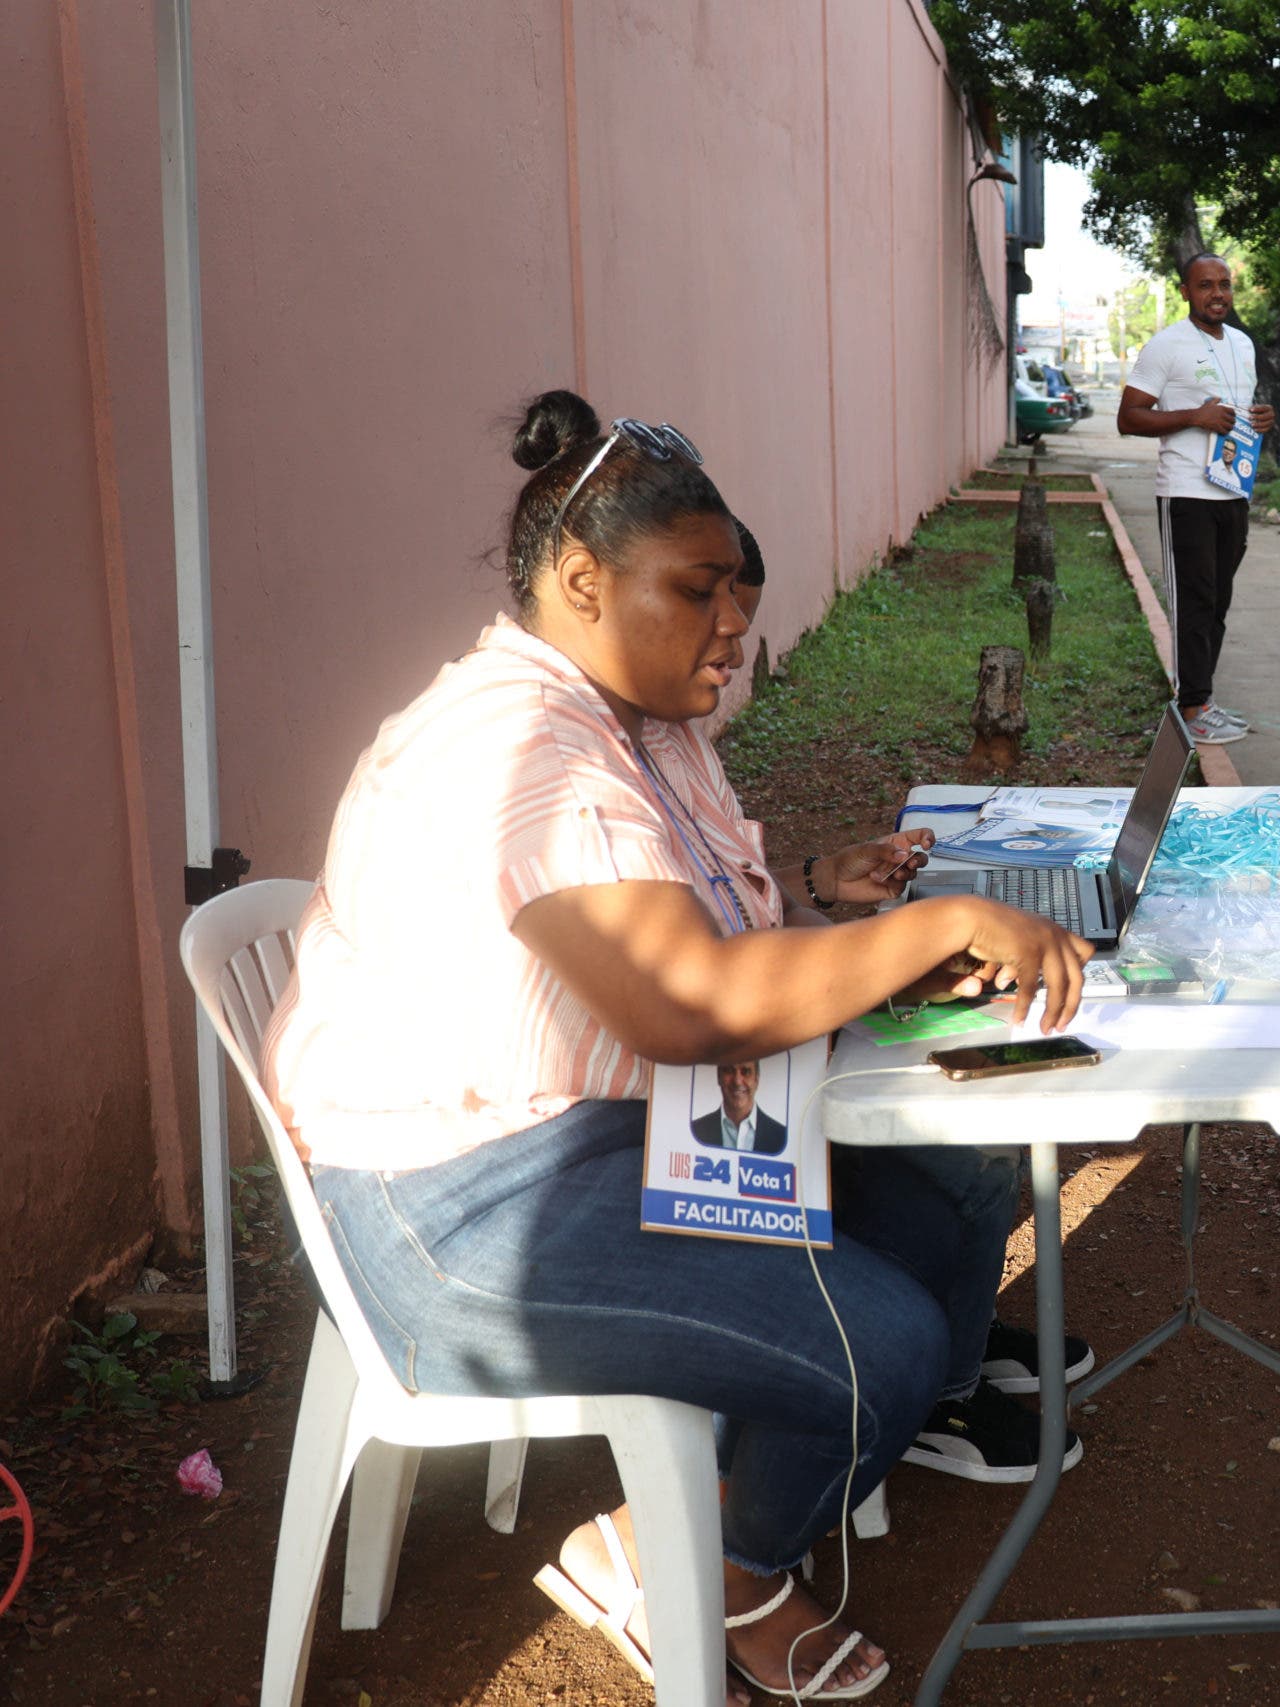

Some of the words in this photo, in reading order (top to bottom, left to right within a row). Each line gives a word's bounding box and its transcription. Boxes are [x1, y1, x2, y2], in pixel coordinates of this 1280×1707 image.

[1239, 462, 1250, 475] 15
[668, 1152, 691, 1180] LUIS
[693, 1155, 731, 1185] 24
[739, 1166, 780, 1189] Vota
[783, 1173, 791, 1192] 1
[673, 1200, 806, 1234] FACILITADOR
